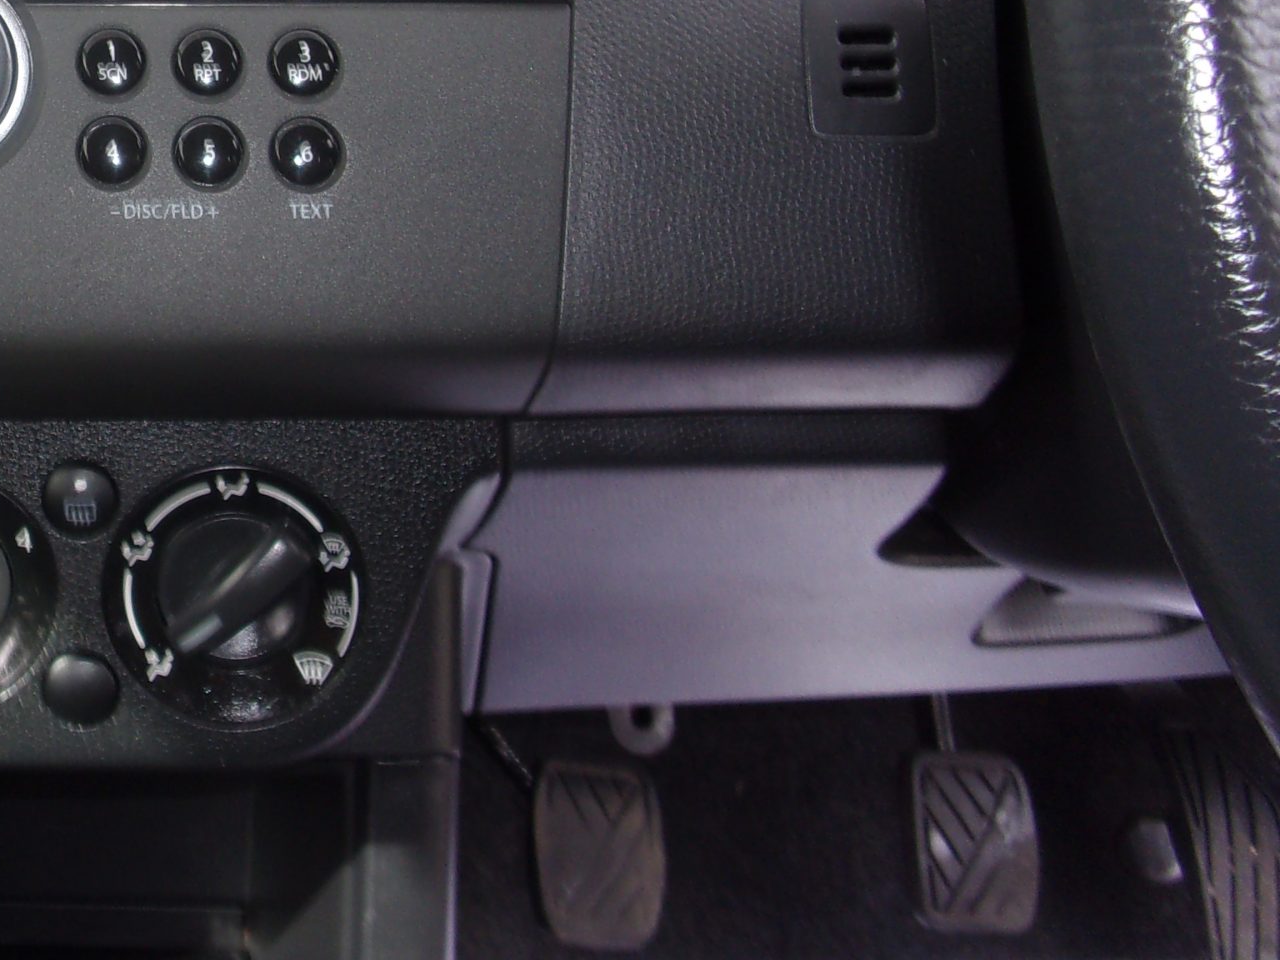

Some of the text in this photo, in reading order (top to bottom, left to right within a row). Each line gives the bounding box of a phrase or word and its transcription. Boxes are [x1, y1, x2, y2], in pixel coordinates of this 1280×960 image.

[106, 40, 116, 62] 1
[201, 40, 215, 64] 2
[298, 40, 312, 64] 3
[97, 62, 128, 82] SCN
[193, 62, 221, 82] RPT
[287, 62, 324, 82] RDM
[105, 140, 120, 160] 4
[203, 140, 217, 161] 5
[299, 140, 314, 162] 6
[288, 200, 333, 219] TEXT
[15, 526, 34, 554] 4
